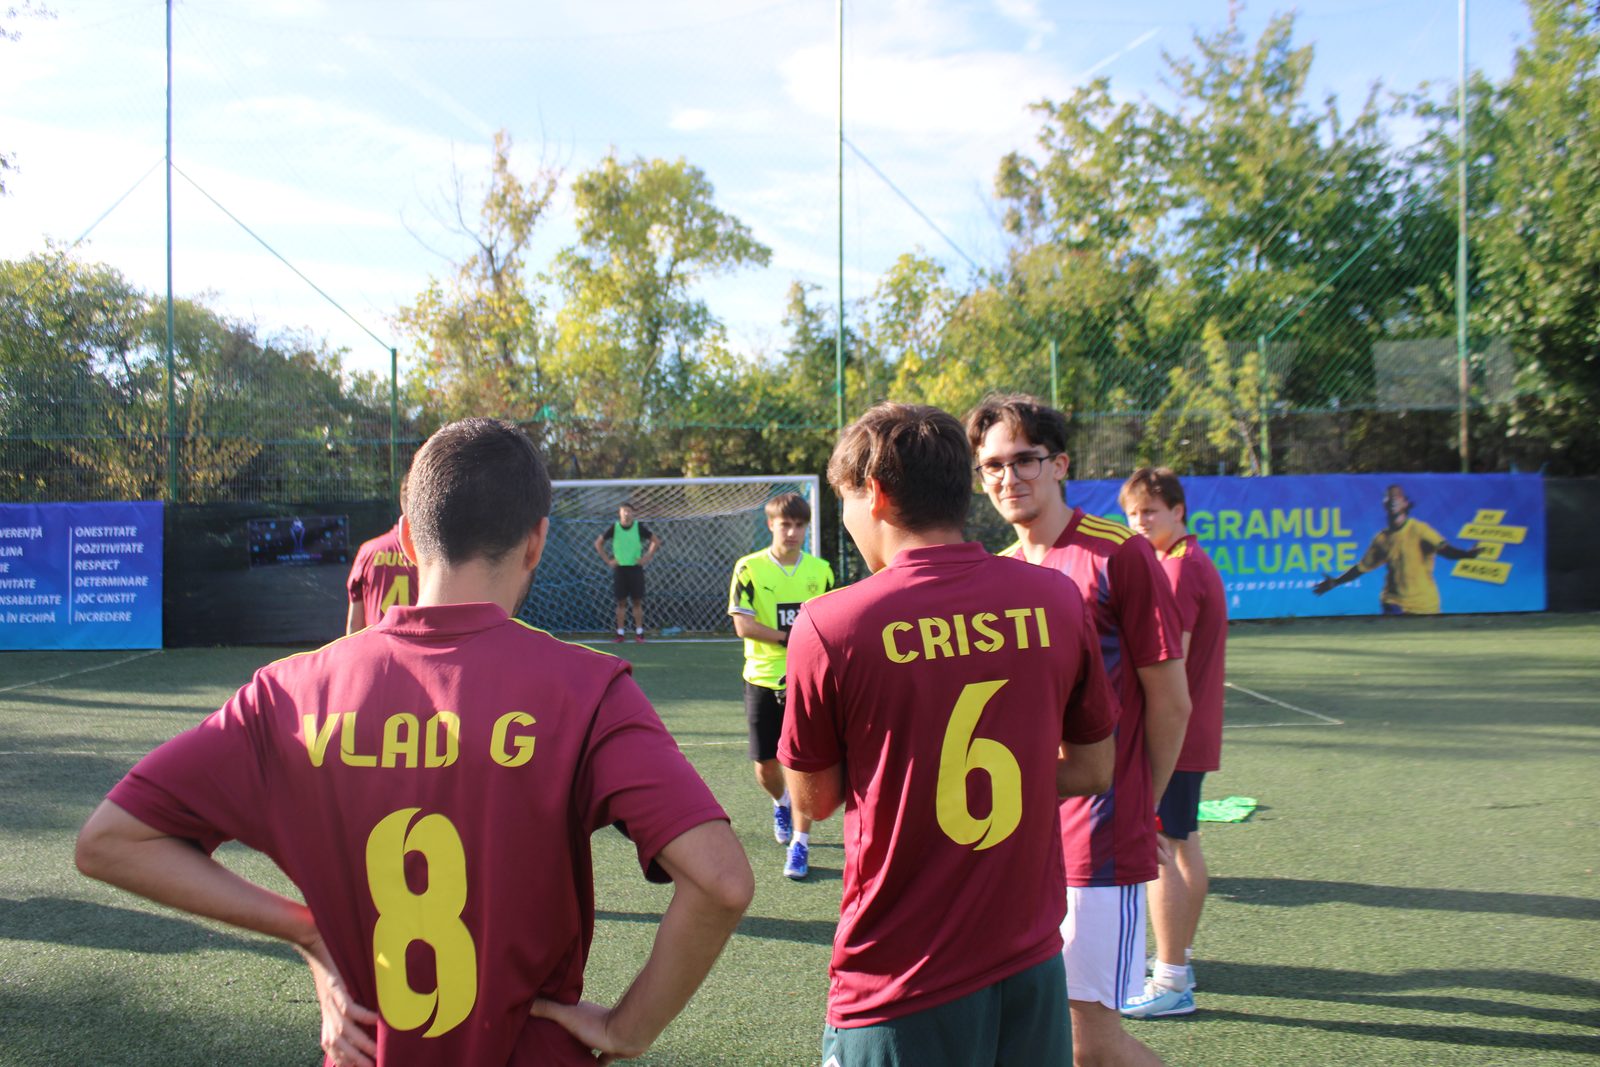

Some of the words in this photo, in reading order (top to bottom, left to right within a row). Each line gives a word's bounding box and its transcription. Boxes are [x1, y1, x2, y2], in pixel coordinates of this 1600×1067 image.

[74, 526, 137, 537] ONESTITATE
[1186, 507, 1353, 541] GRAMUL
[74, 542, 144, 554] POZITIVITATE
[1208, 542, 1358, 575] ALUARE
[74, 559, 120, 571] RESPECT
[74, 576, 149, 587] DETERMINARE
[74, 593, 95, 604] JOC
[97, 592, 137, 603] CINSTIT
[881, 607, 1050, 664] CRISTI
[303, 710, 460, 768] VLAD
[490, 711, 537, 768] G
[936, 679, 1023, 851] 6
[365, 807, 478, 1039] 8
